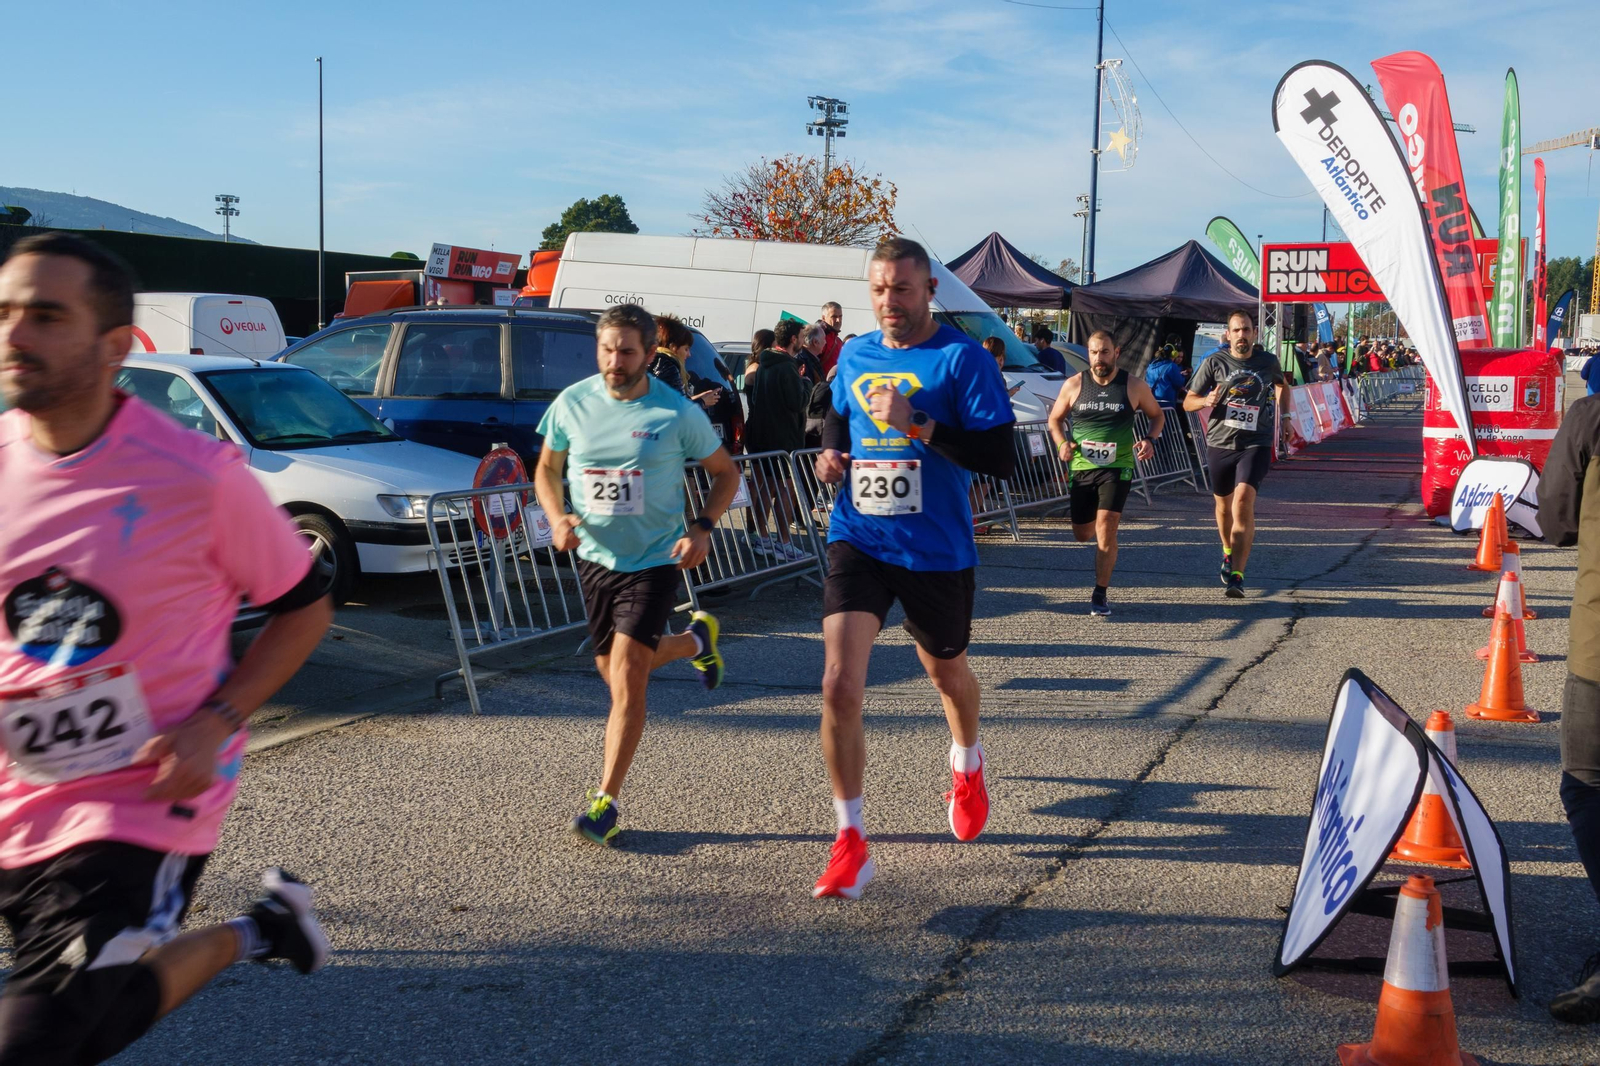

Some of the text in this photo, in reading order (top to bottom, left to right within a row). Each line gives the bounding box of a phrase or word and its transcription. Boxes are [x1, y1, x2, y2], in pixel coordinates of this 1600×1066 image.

[1318, 125, 1387, 214] DEPORTE
[1320, 156, 1369, 221] Atlántico
[432, 247, 450, 257] MILLA
[457, 250, 479, 264] RUN
[1269, 250, 1328, 272] RUN
[428, 266, 444, 275] VIGO
[604, 293, 644, 306] acción
[234, 321, 267, 332] VEOLIA
[1472, 394, 1501, 404] VIGO
[1230, 410, 1254, 423] 238
[1486, 433, 1498, 442] de
[1501, 435, 1524, 444] xogo
[1087, 448, 1110, 460] 219
[593, 481, 631, 502] 231
[859, 475, 911, 499] 230
[14, 697, 128, 755] 242
[1317, 747, 1365, 915] Atlántico
